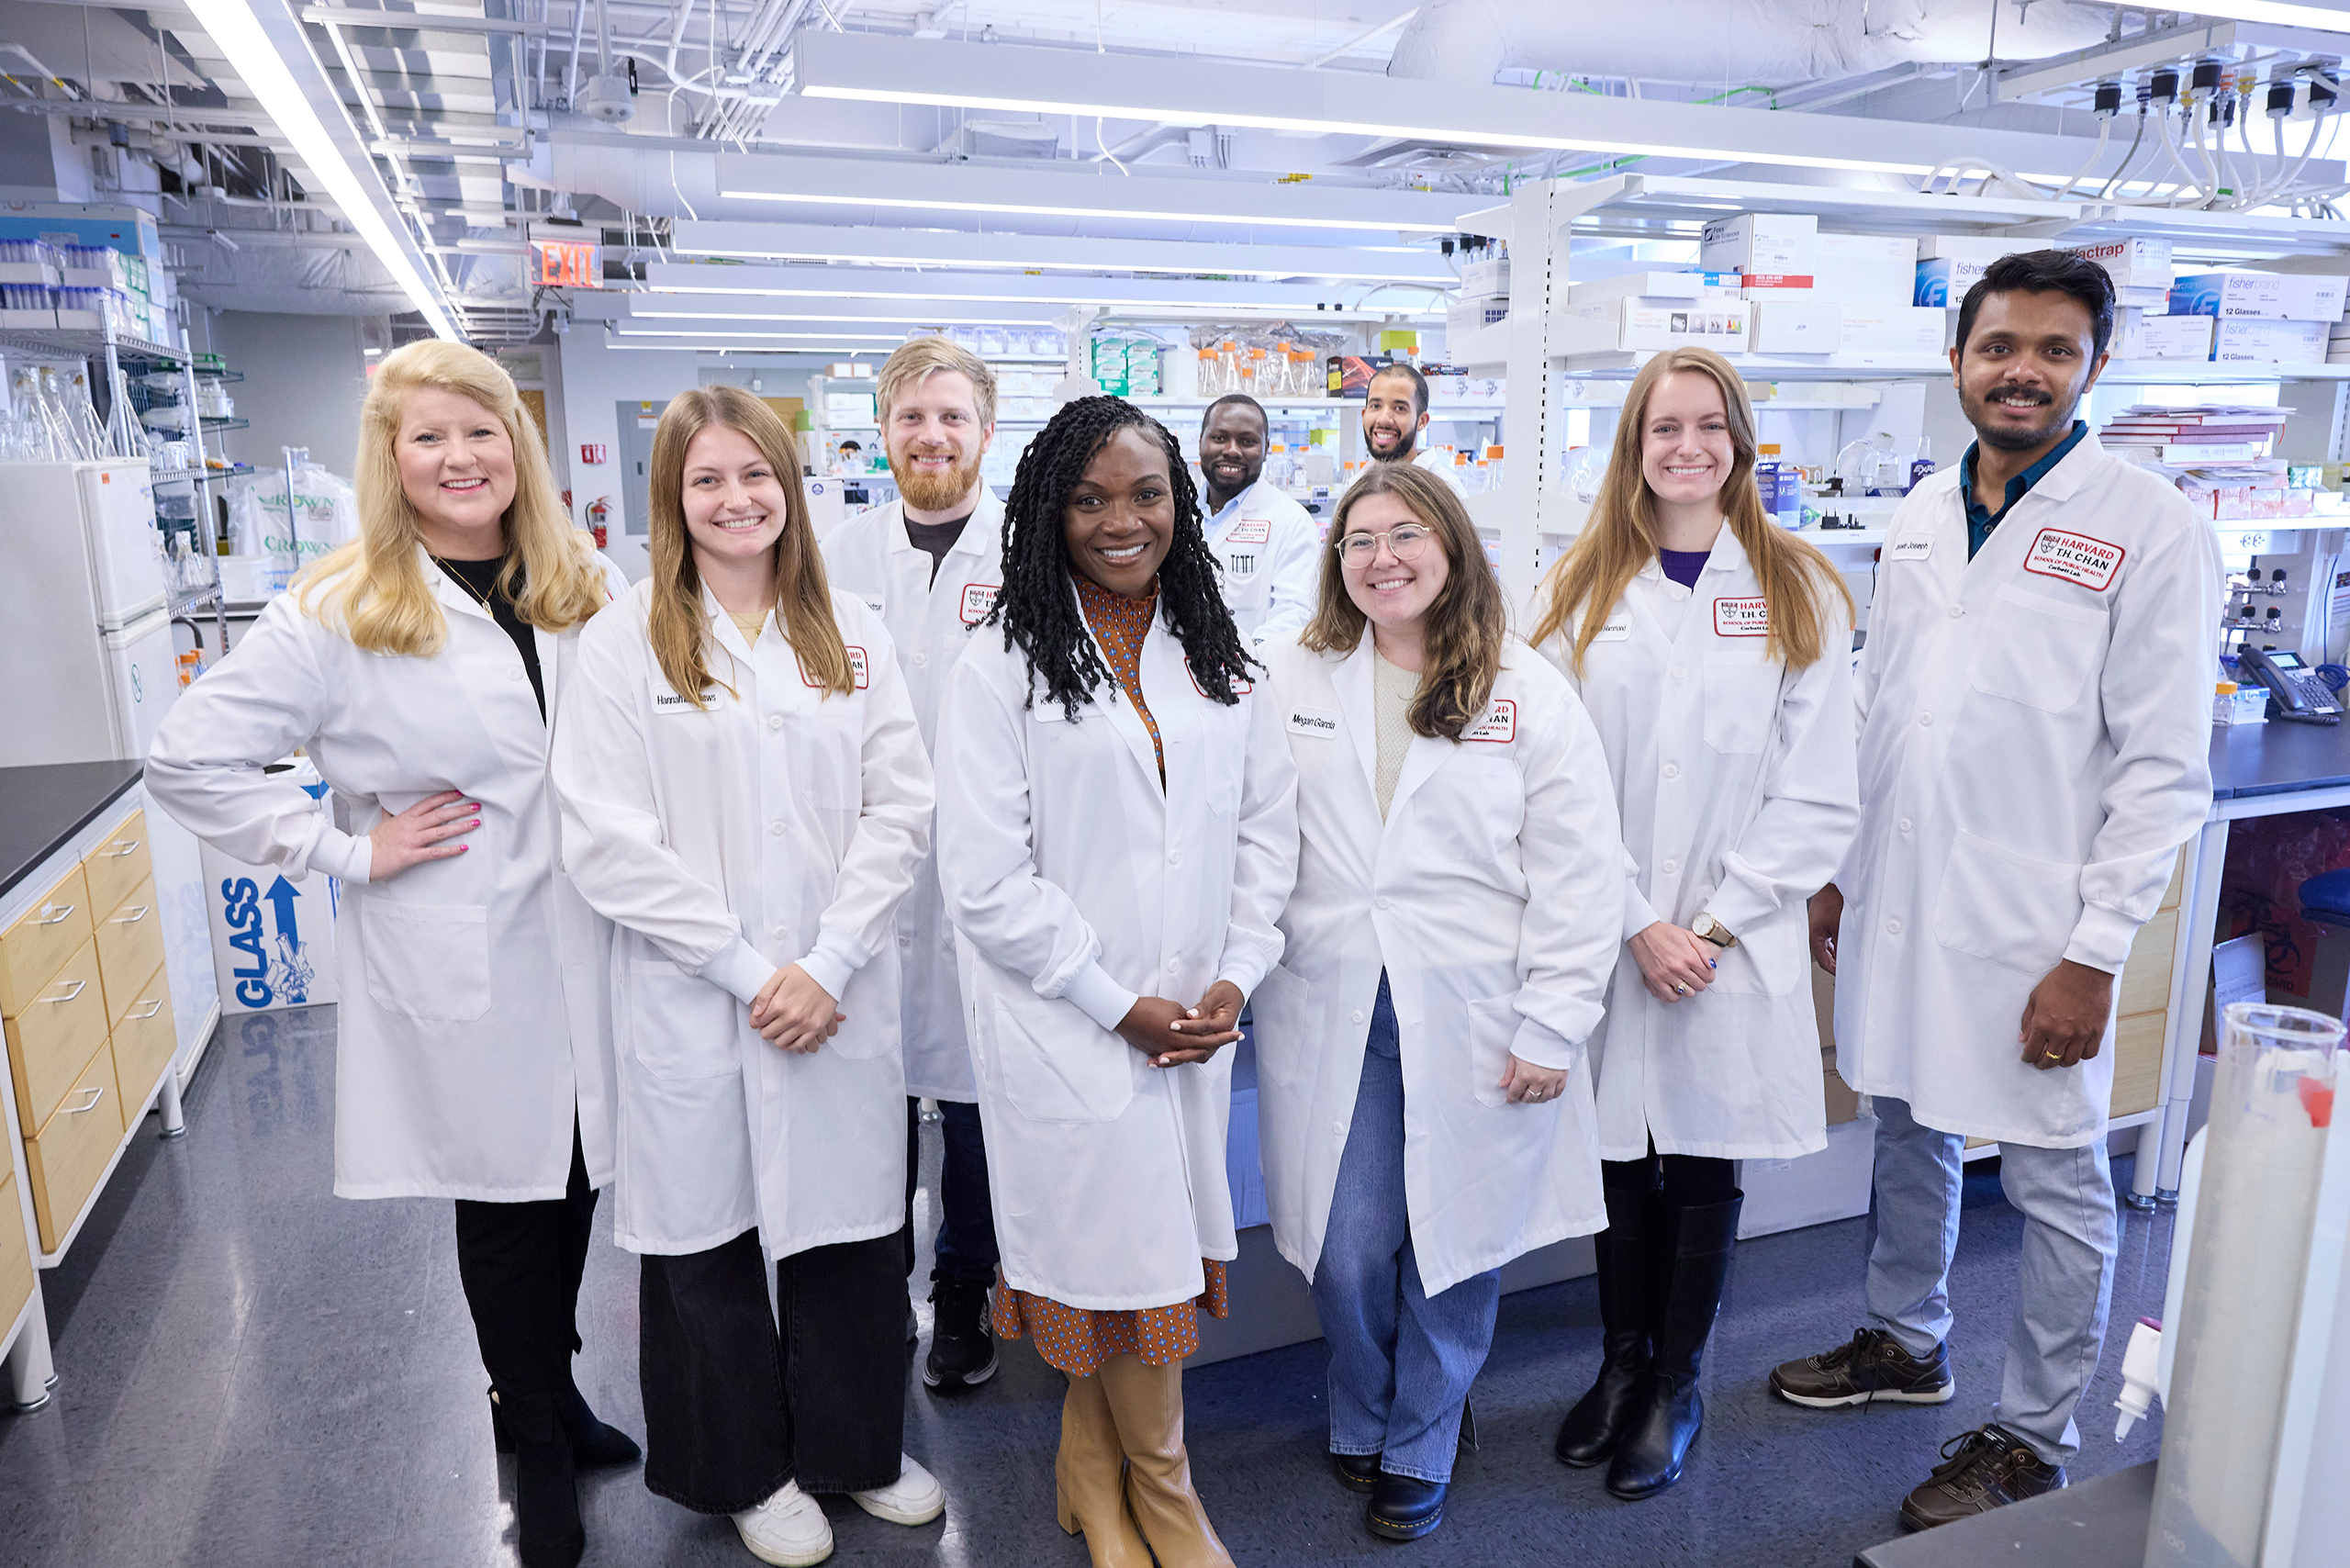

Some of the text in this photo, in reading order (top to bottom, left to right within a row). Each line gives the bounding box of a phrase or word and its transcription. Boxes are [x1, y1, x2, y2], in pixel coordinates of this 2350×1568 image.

[542, 242, 596, 286] EXIT
[1956, 262, 1986, 275] fisher
[2229, 276, 2281, 290] fisherbrand
[2234, 308, 2261, 316] Glasses
[2225, 323, 2271, 336] fisherbrand
[2231, 353, 2255, 361] Glasses
[2060, 538, 2114, 560] HARVARD
[2056, 548, 2109, 570] T.H. CHAN
[2033, 555, 2054, 564] SCHOOL
[2062, 561, 2082, 570] PUBLIC
[2081, 566, 2105, 578] HEALTH
[2069, 569, 2081, 577] Lab
[1740, 601, 1768, 610] HARV
[1292, 713, 1336, 730] Megan Garcia
[221, 877, 274, 1009] GLASS
